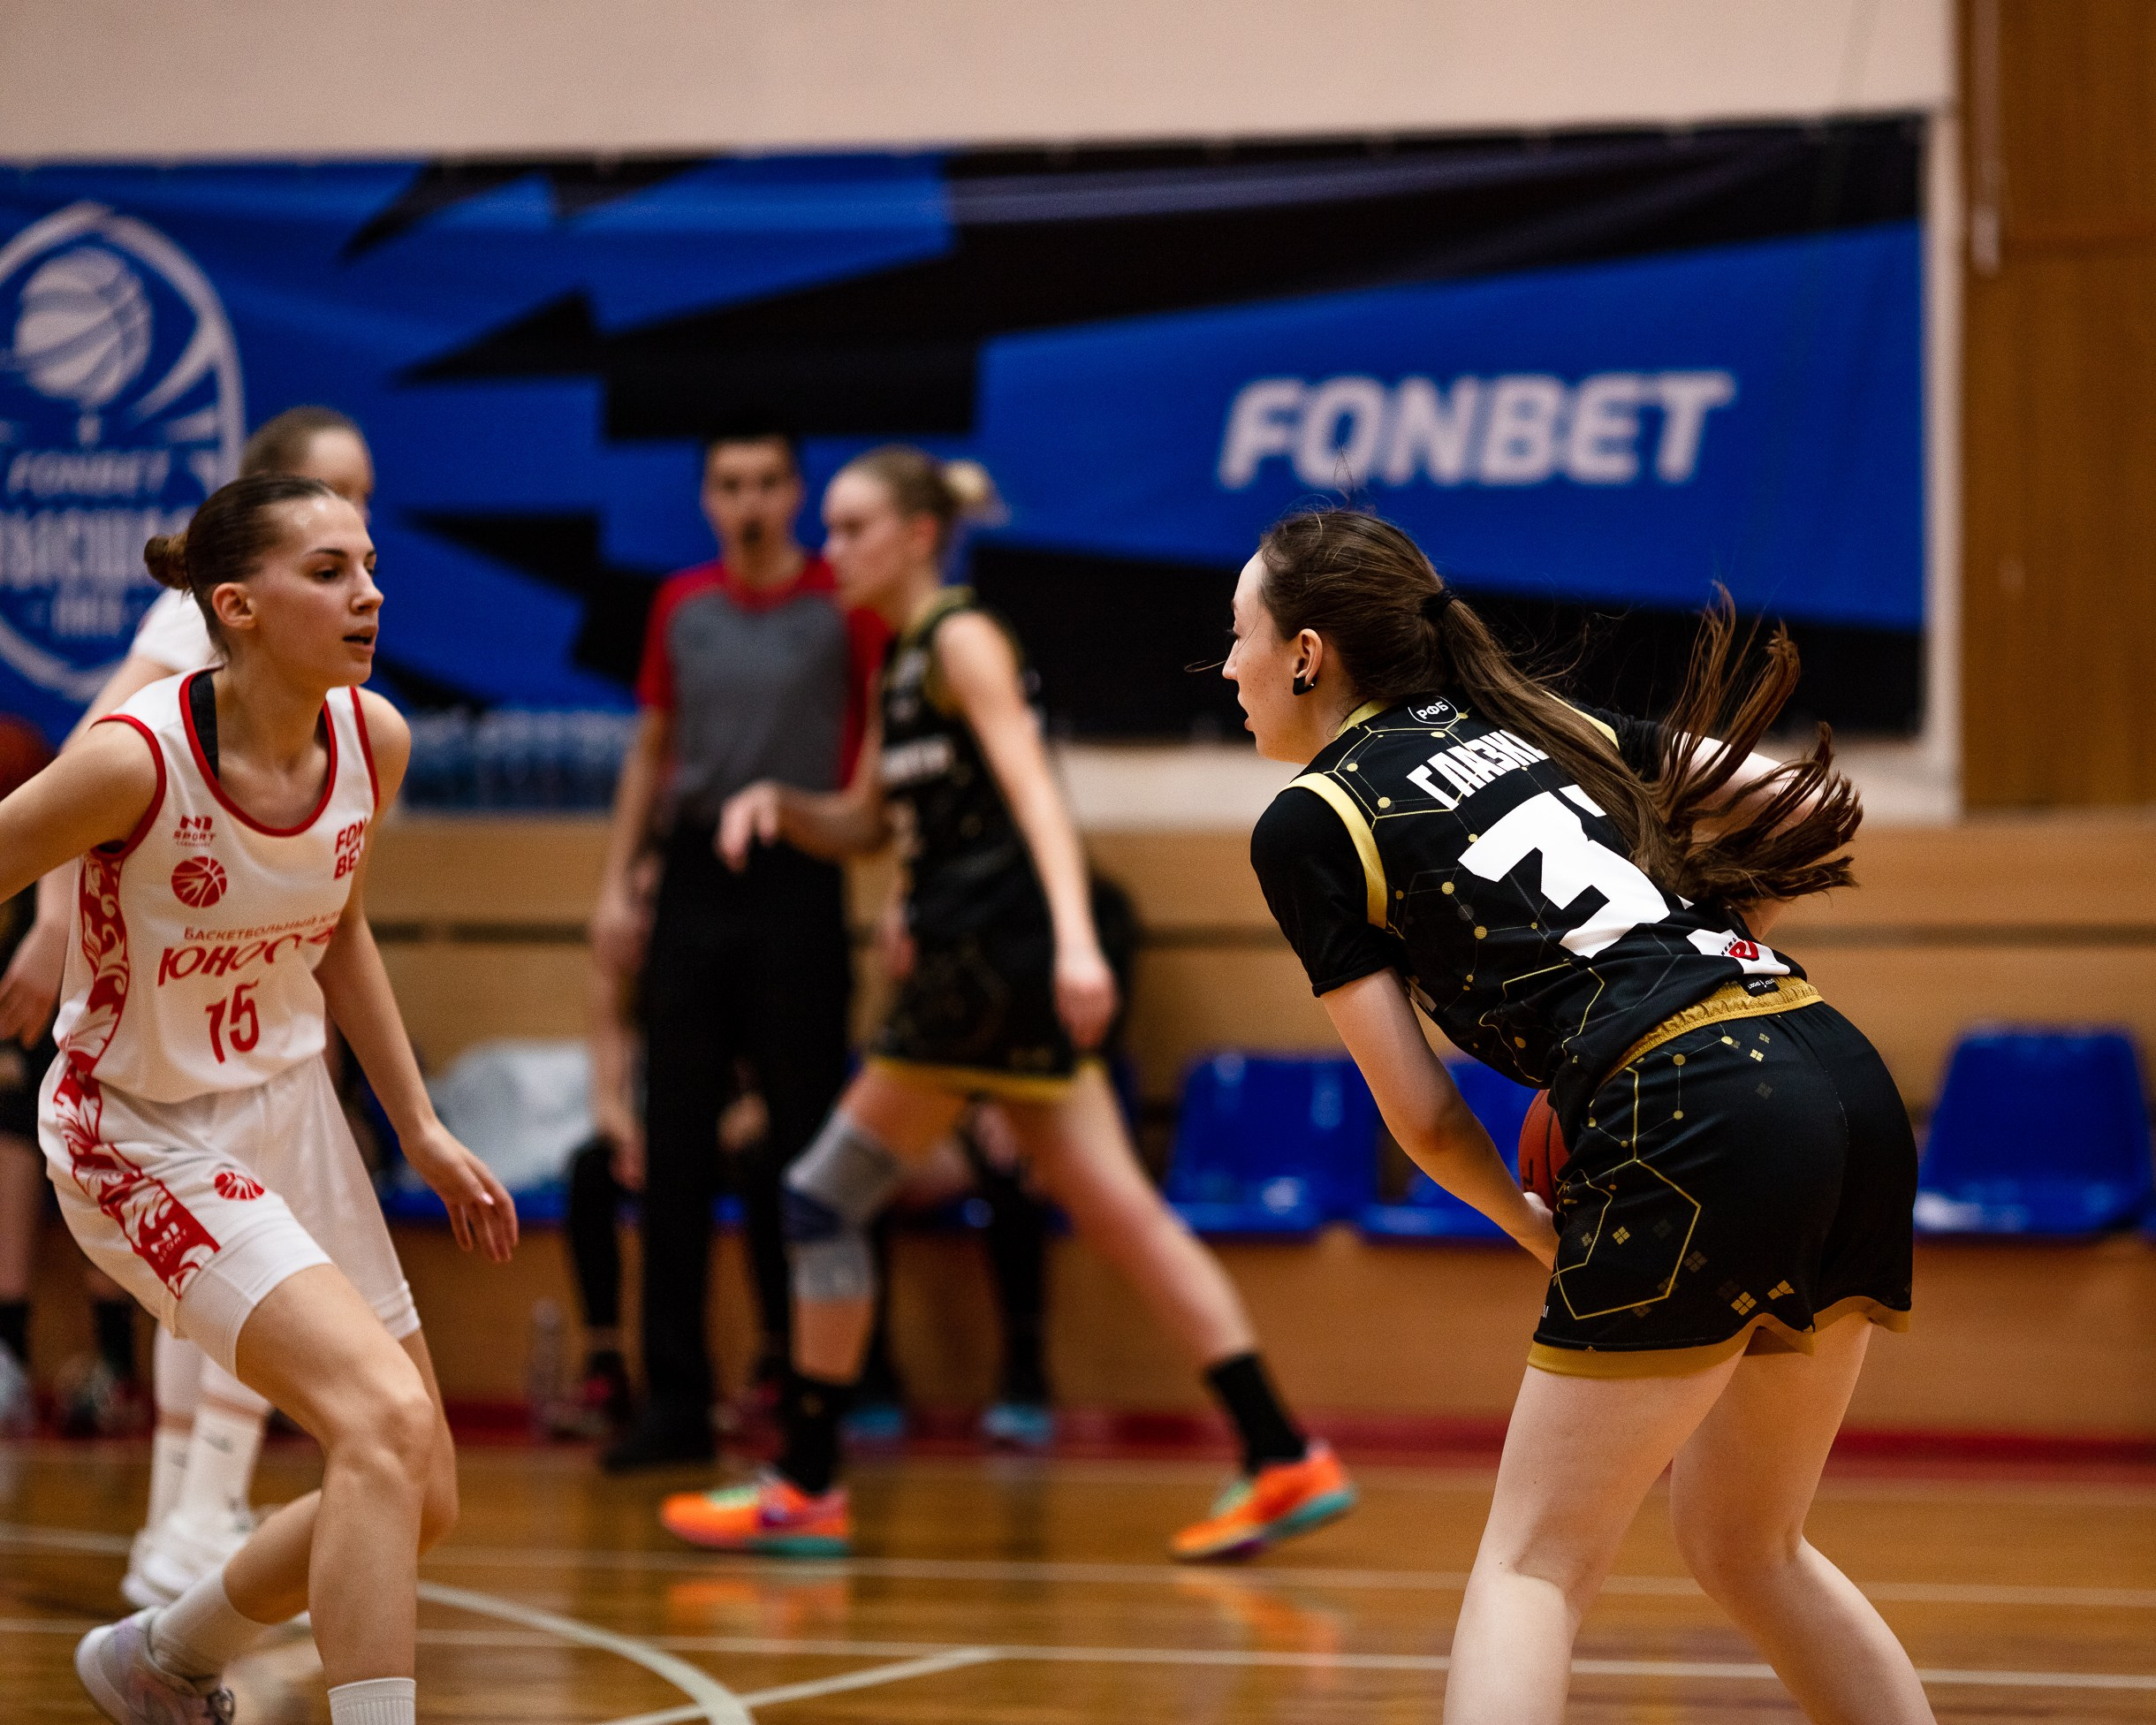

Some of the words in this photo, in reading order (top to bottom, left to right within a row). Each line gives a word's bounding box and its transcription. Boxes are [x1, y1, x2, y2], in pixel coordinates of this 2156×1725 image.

[1219, 369, 1735, 490] FONBET
[1416, 701, 1449, 720] РФБ
[172, 830, 216, 841] SPORT
[205, 977, 260, 1065] 15
